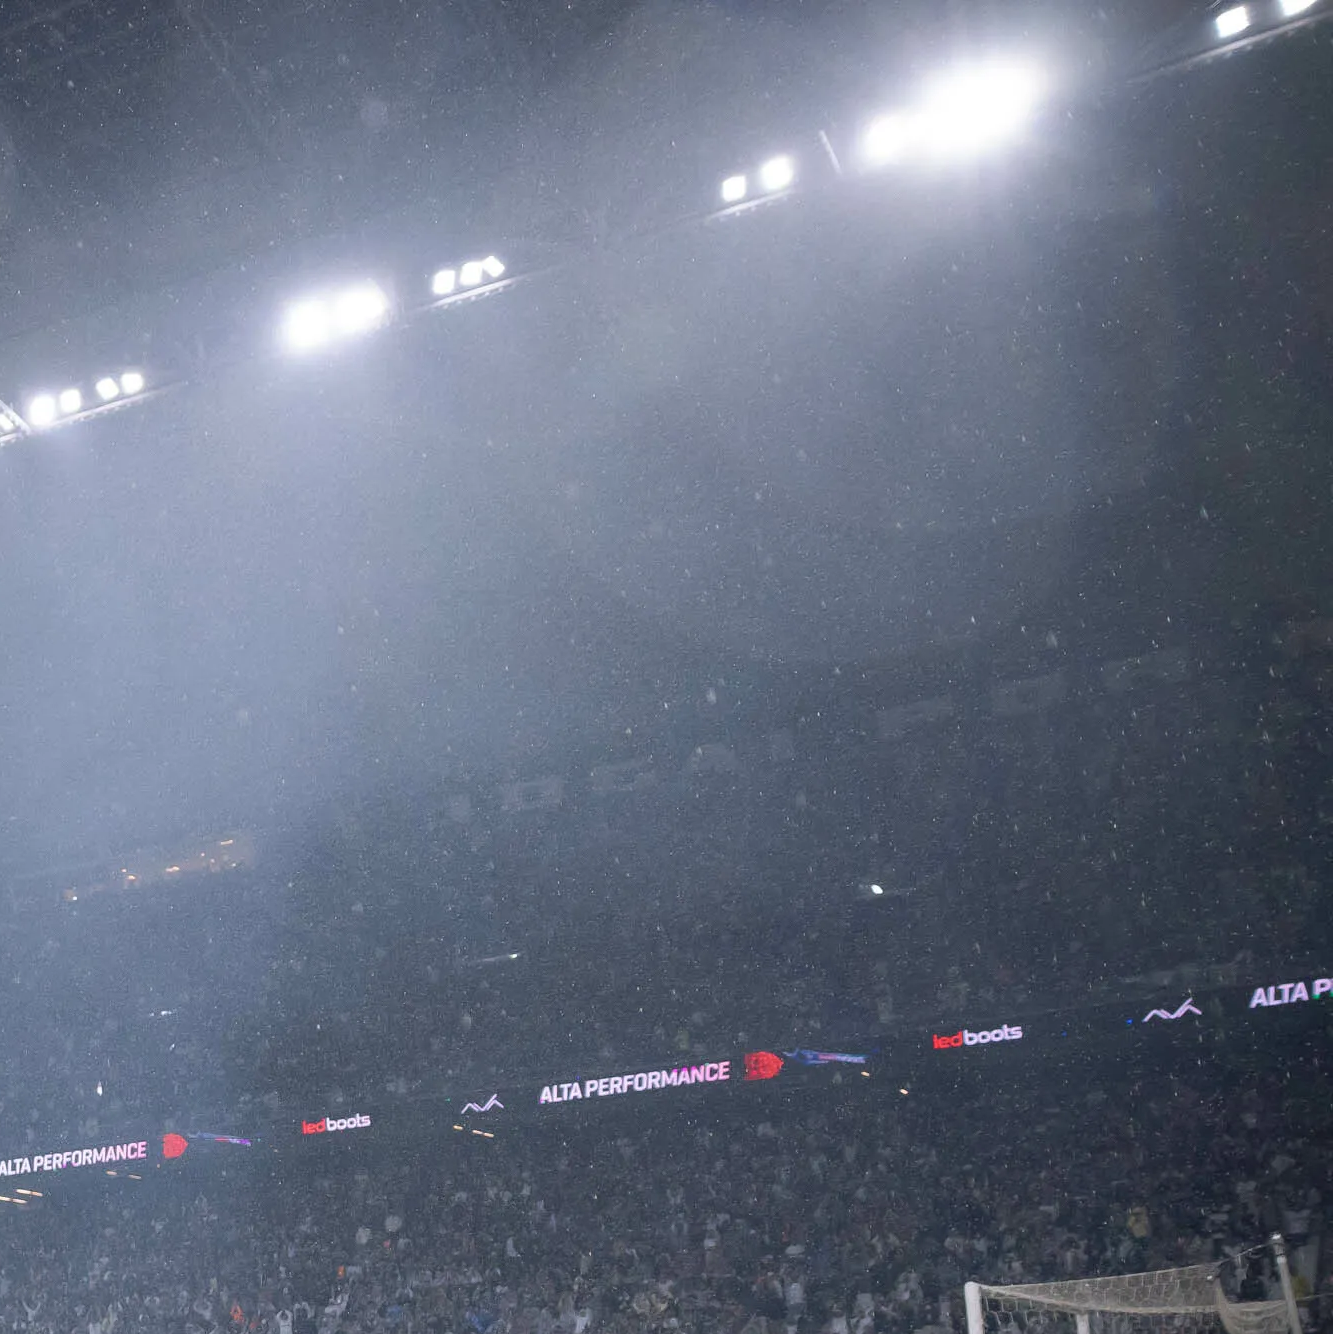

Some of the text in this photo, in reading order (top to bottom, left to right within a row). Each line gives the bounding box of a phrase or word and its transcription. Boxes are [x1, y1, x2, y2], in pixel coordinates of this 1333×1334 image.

[1249, 977, 1333, 1009] ALTA P
[932, 1023, 1023, 1050] ledboots
[540, 1060, 730, 1104] ALTA PERFORMANCE
[302, 1112, 371, 1135] ledboots
[33, 1141, 147, 1173] PERFORMANCE
